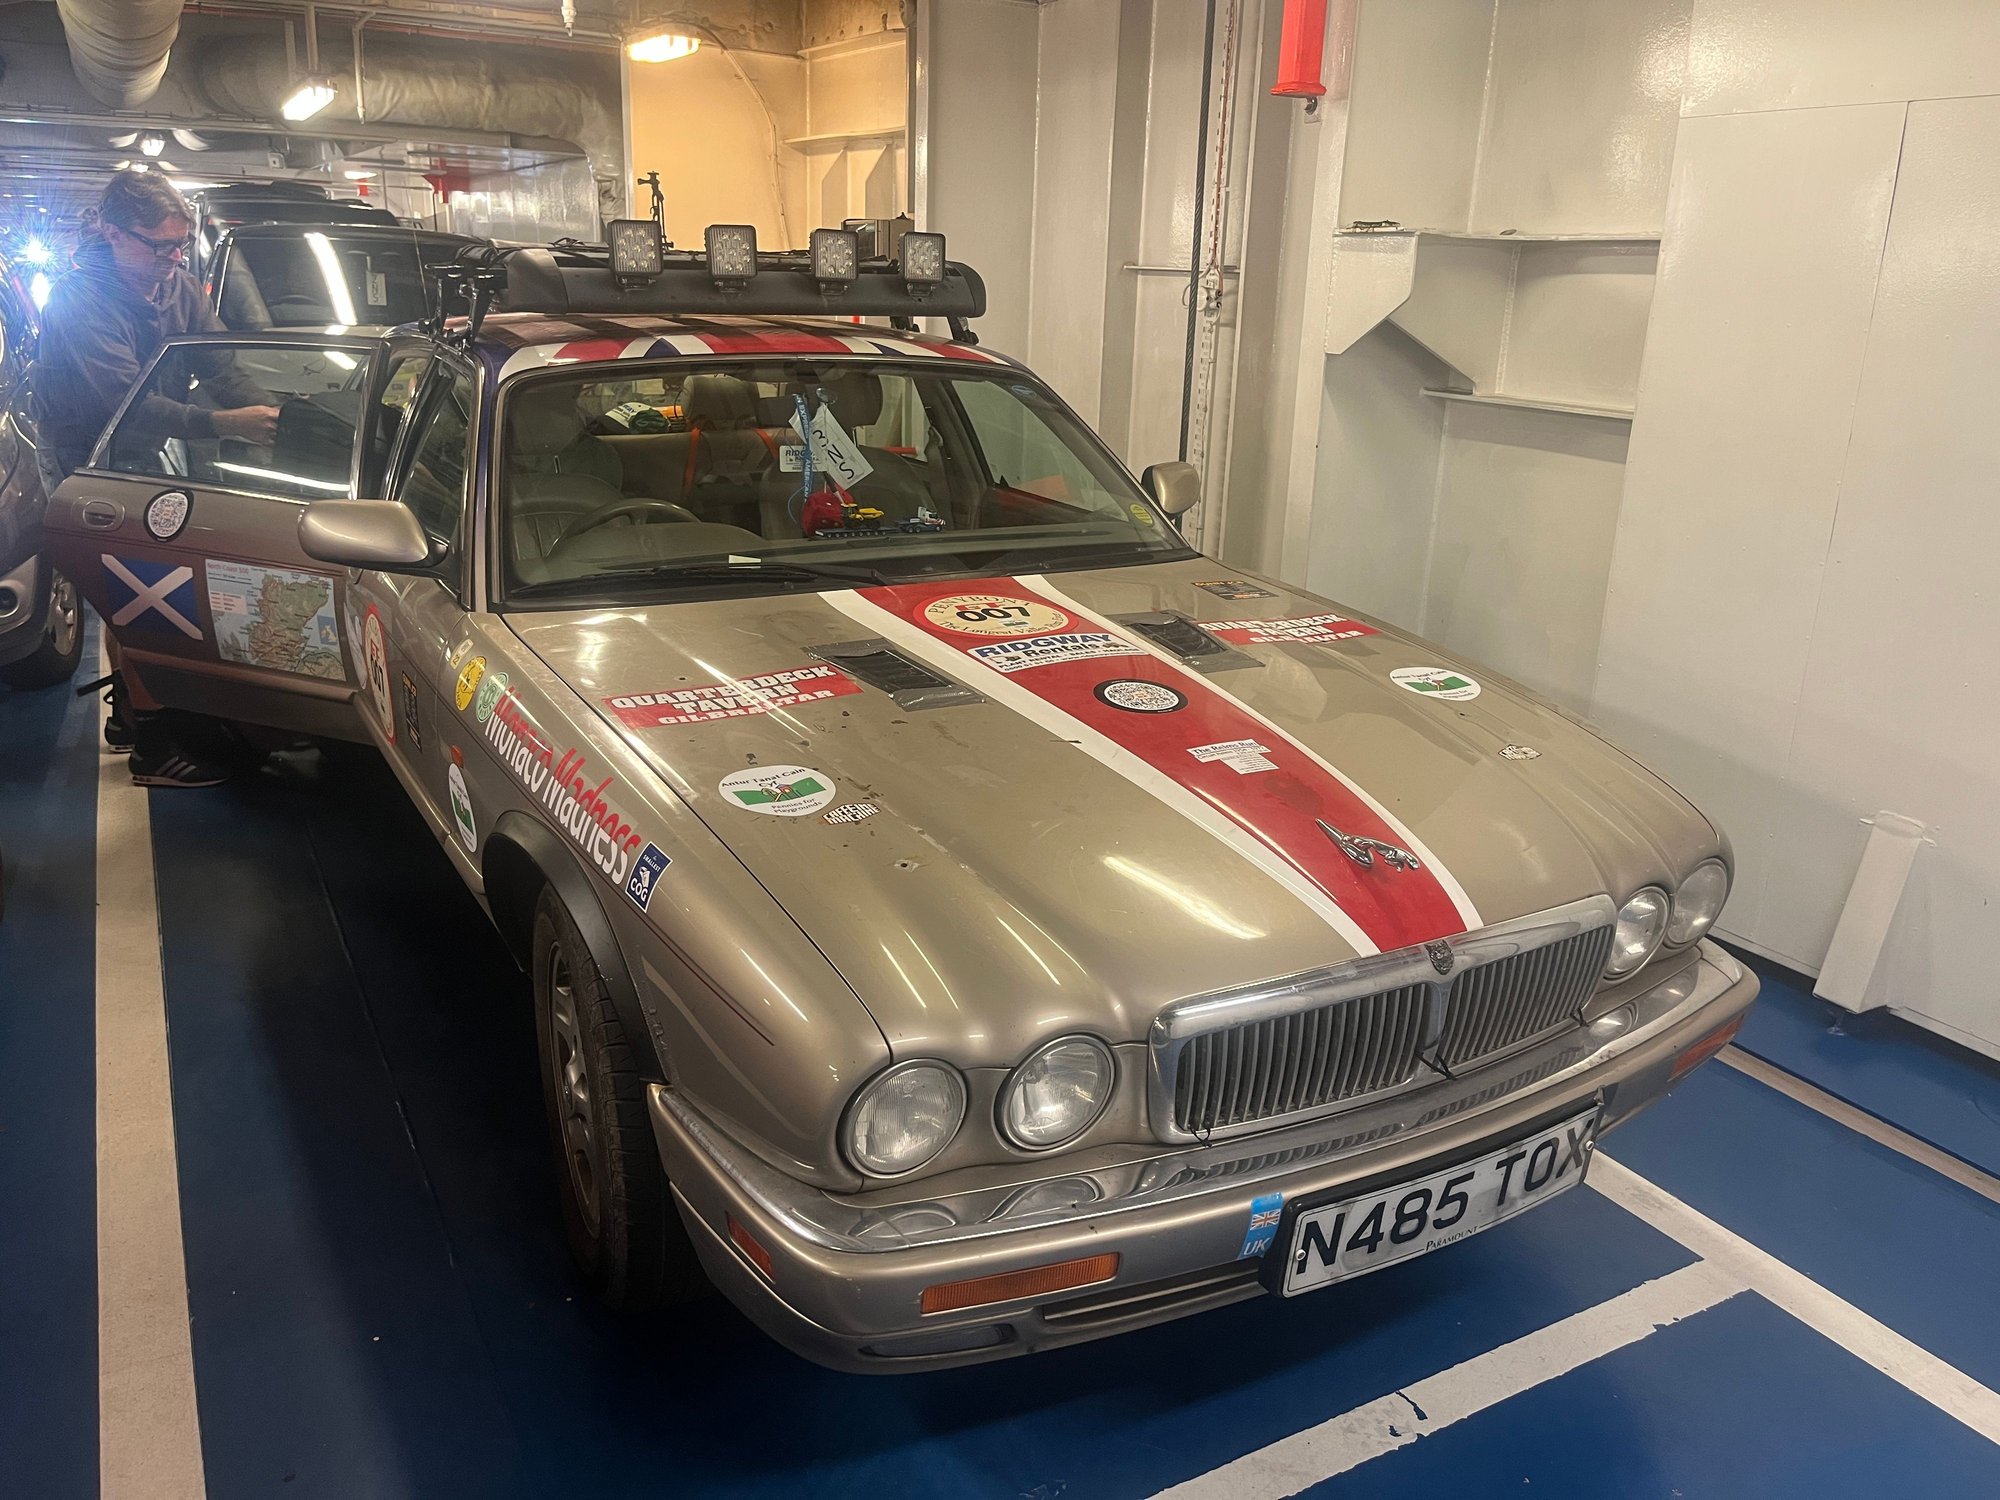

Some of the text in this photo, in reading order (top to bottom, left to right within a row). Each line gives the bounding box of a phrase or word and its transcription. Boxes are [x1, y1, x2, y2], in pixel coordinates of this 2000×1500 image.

[956, 606, 1031, 622] 007
[975, 634, 1113, 657] RIDGWAY
[1023, 642, 1099, 657] Rentals
[611, 665, 837, 710] QUARTERDECK
[674, 682, 802, 715] TAVERN
[782, 767, 806, 777] Cain
[542, 748, 642, 885] Madness
[642, 854, 662, 873] SMALLEST
[630, 877, 650, 902] COG
[1296, 1119, 1595, 1276] N485 TOX
[1243, 1237, 1271, 1257] UK
[1425, 1225, 1479, 1252] PARAMOUNT
